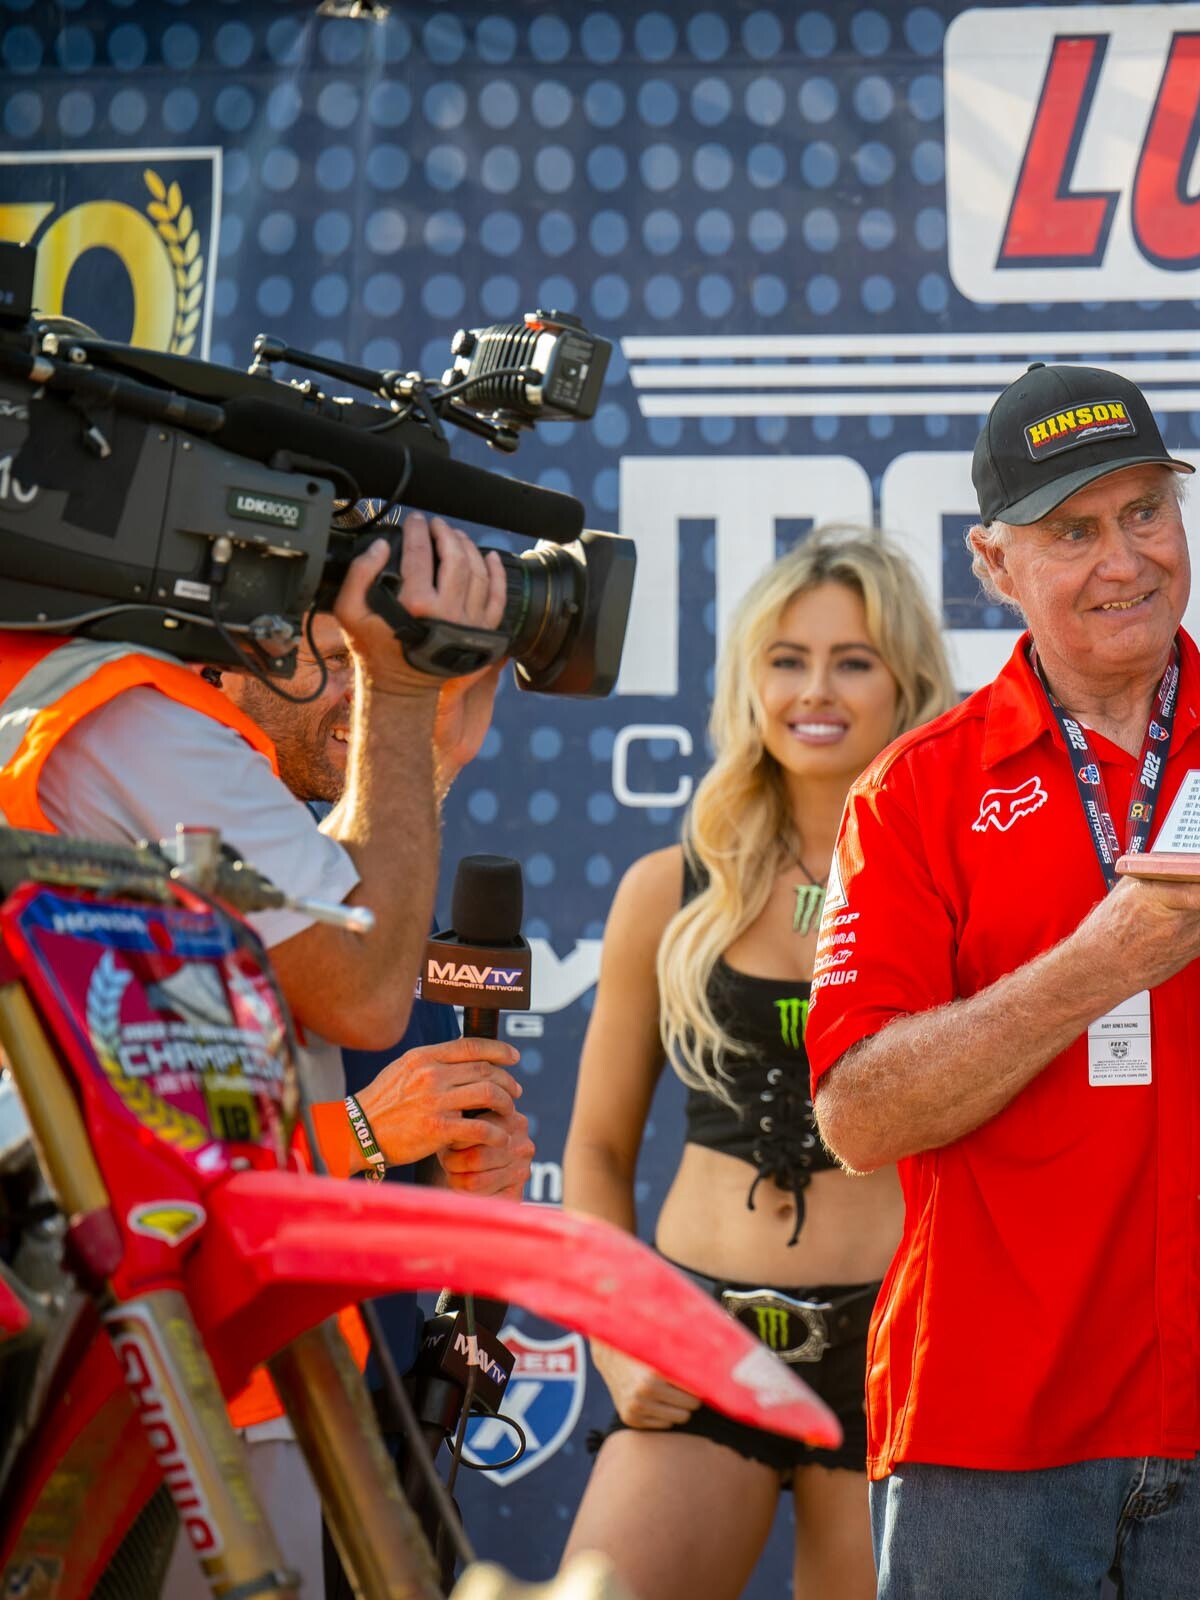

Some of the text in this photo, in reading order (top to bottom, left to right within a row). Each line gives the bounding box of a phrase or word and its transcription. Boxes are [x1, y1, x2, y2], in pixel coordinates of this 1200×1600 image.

[1029, 403, 1126, 444] HINSON
[1063, 719, 1088, 751] 2022
[1140, 751, 1161, 789] 2022
[1087, 800, 1113, 865] MOTOCROSS
[427, 976, 485, 990] MOTORSPORTS
[485, 983, 524, 993] NETWORK
[352, 1118, 374, 1149] FOX
